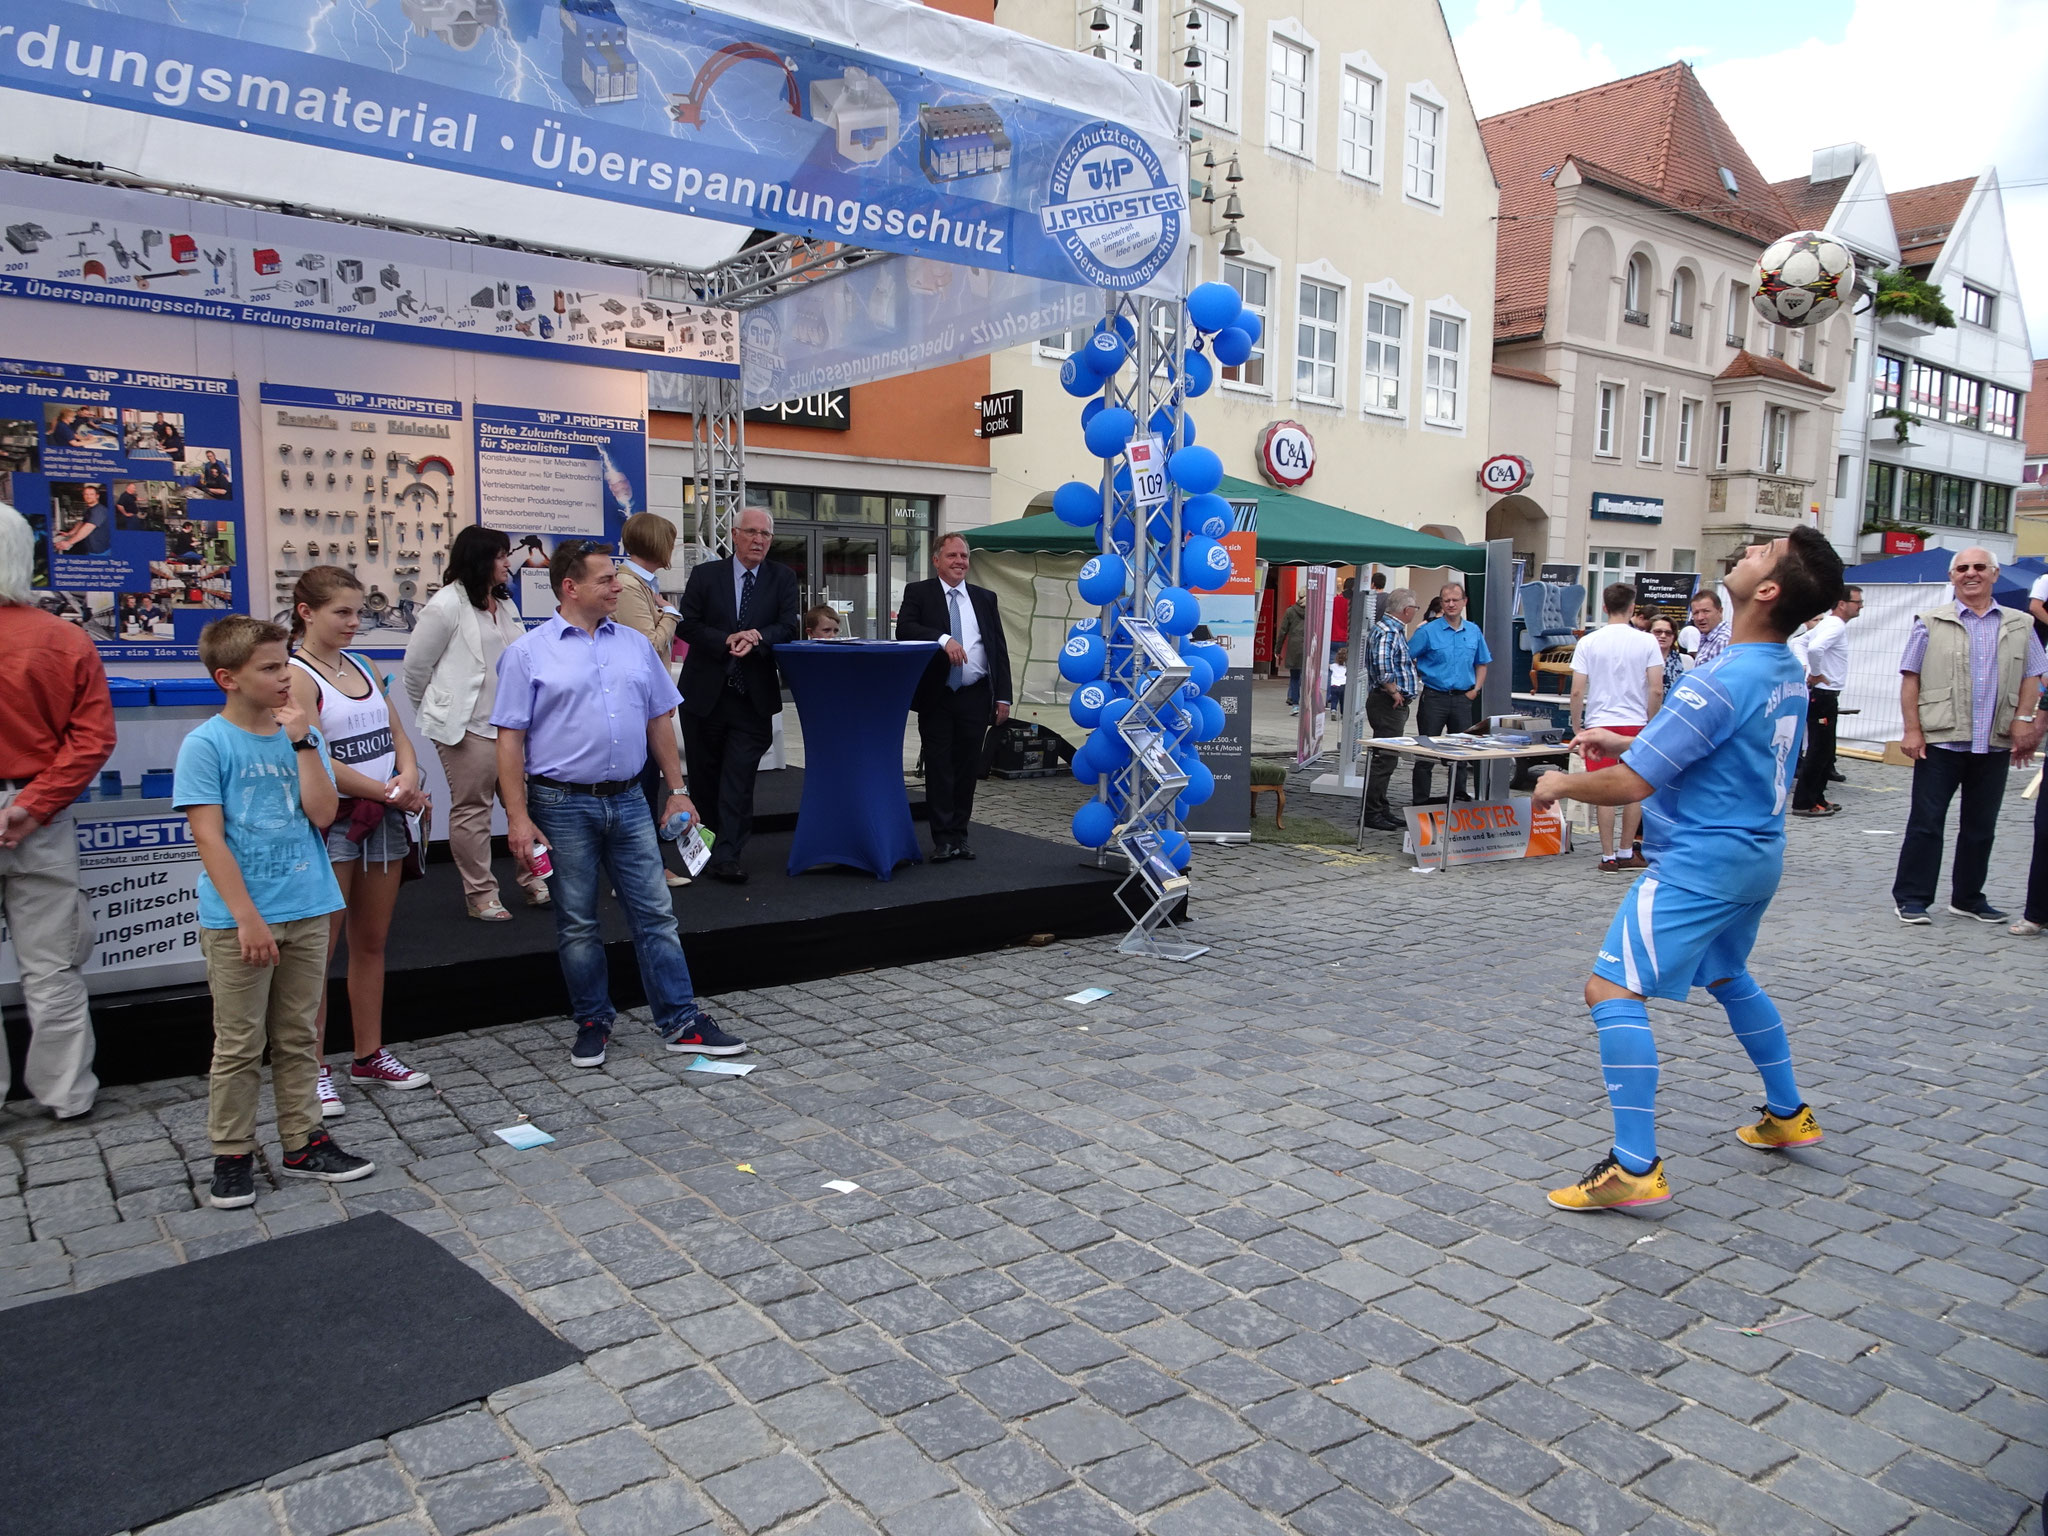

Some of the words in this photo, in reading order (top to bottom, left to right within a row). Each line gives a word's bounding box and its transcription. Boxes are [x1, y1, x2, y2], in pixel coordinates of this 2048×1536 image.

[1054, 128, 1160, 195] Blitzschutztechnik
[531, 119, 1004, 255] Überspannungsschutz
[1046, 191, 1182, 231] J.PRÖPSTER
[1089, 238, 1101, 249] mit
[1101, 223, 1135, 243] Sicherheit
[1104, 238, 1126, 254] immer
[1126, 230, 1140, 243] eine
[1066, 217, 1176, 288] Überspannungsschutz
[1115, 246, 1131, 258] Idee
[1133, 232, 1158, 251] voraus!
[5, 261, 29, 272] 2001
[57, 268, 81, 278] 2002
[108, 275, 131, 285] 2003
[204, 287, 226, 297] 2004
[250, 293, 271, 303] 2005
[25, 279, 235, 321] Überspannungsschutz,
[242, 307, 375, 336] Erdungsmaterial
[294, 299, 315, 309] 2006
[337, 305, 357, 314] 2007
[379, 309, 398, 319] 2008
[418, 314, 437, 323] 2009
[458, 319, 476, 328] 2010
[495, 323, 513, 334] 2012
[567, 332, 584, 342] 2013
[602, 337, 618, 347] 2014
[667, 345, 683, 354] 2015
[699, 349, 714, 358] 2016
[123, 373, 228, 393] J.PRÖPSTER
[26, 383, 58, 397] ihre
[62, 387, 111, 401] Arbeit
[367, 397, 453, 415] J.PRÖPSTER
[983, 396, 1014, 418] MATT
[564, 415, 639, 431] J.PRÖPSTER
[986, 418, 1009, 434] optik
[480, 423, 517, 436] Starke
[520, 426, 611, 444] Zukunftschancen
[480, 437, 497, 449] für
[500, 439, 570, 454] Spezialisten!
[1275, 438, 1308, 469] C&A
[481, 452, 526, 464] Konstrukteur
[543, 456, 552, 465] für
[554, 459, 587, 468] Mechanik
[481, 467, 527, 477] Konstrukteur
[543, 470, 553, 478] für
[555, 472, 602, 482] Elektrotechnik
[1488, 465, 1517, 482] C&A
[482, 480, 551, 492] Vertriebsmitarbeiter
[1139, 473, 1162, 496] 109
[482, 494, 525, 504] Technischer
[527, 497, 583, 508] Produktdesigner
[483, 508, 556, 520] Versandvorbereitung
[895, 509, 915, 518] MATT
[549, 524, 576, 533] Lagerist
[1256, 615, 1267, 656] SALE
[126, 649, 149, 657] eine
[154, 648, 177, 657] Idee
[182, 649, 199, 657] vor
[347, 715, 365, 730] ARE
[80, 856, 127, 866] litzschutz
[131, 854, 149, 862] und
[153, 850, 199, 861] Erdungsm
[88, 871, 168, 900] zschutz
[108, 888, 199, 919] Blitzschu
[102, 937, 176, 967] Innerer
